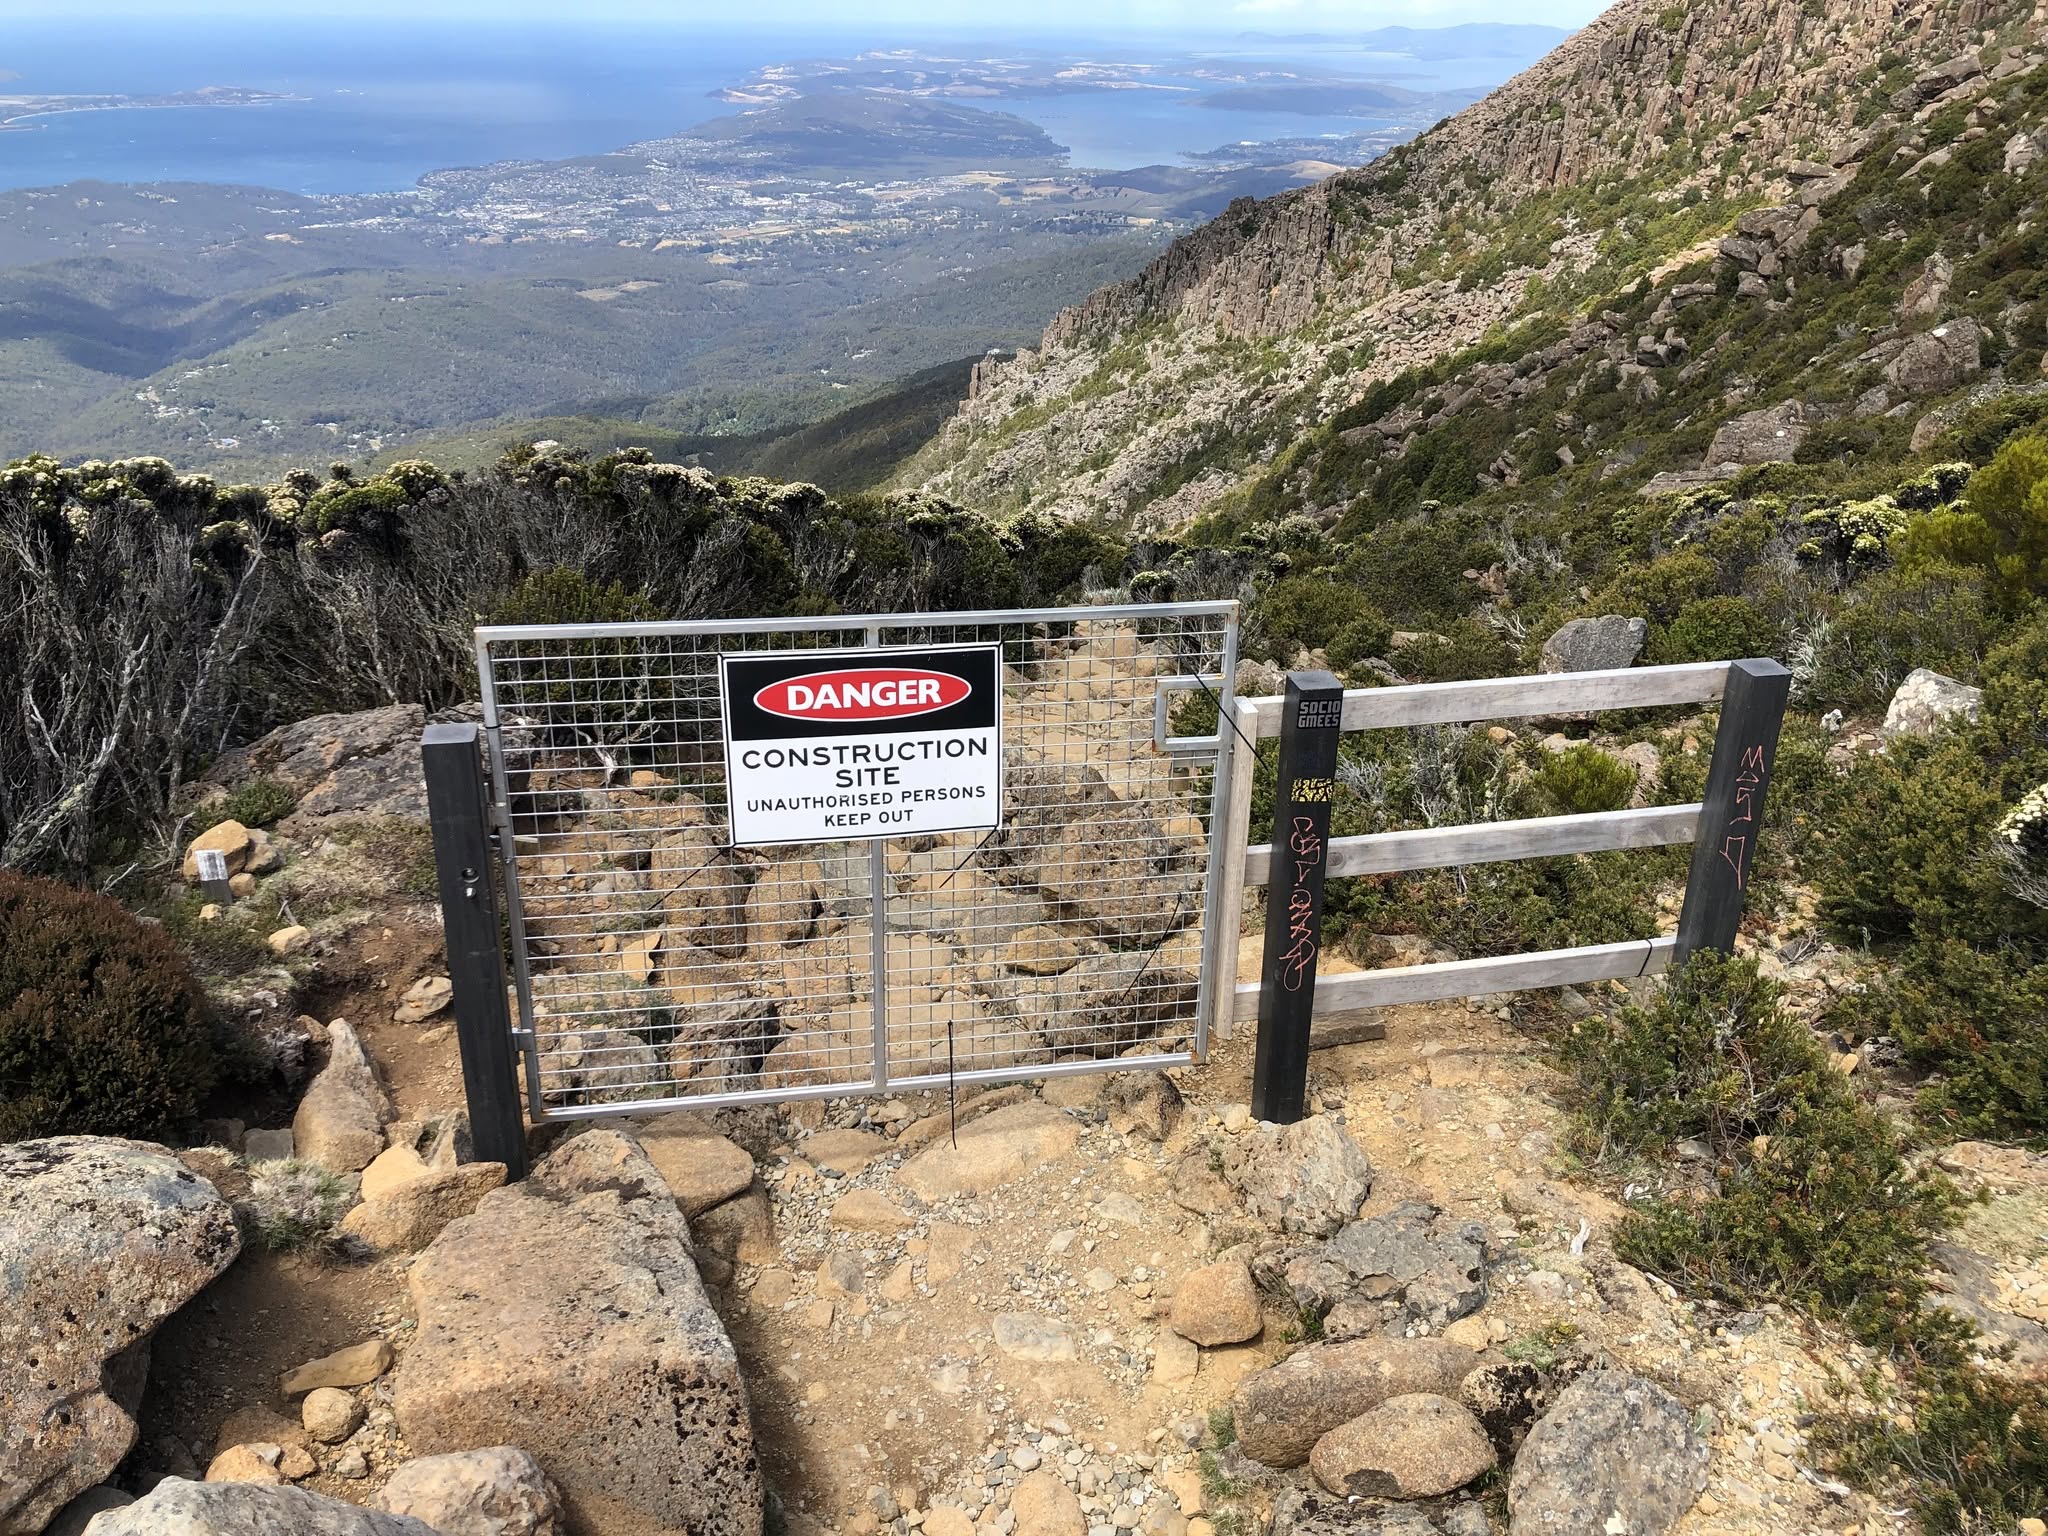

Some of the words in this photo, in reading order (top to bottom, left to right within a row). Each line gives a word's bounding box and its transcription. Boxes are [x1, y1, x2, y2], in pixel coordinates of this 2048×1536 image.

[786, 679, 942, 711] DANGER
[1299, 700, 1341, 714] SOCIO
[1297, 714, 1340, 728] GMEES
[742, 737, 987, 769] CONSTRUCTION
[835, 766, 900, 788] SITE
[747, 792, 893, 812] UNAUTHORISED
[901, 786, 986, 803] PERSONS
[824, 813, 871, 828] KEEP
[879, 809, 914, 823] OUT
